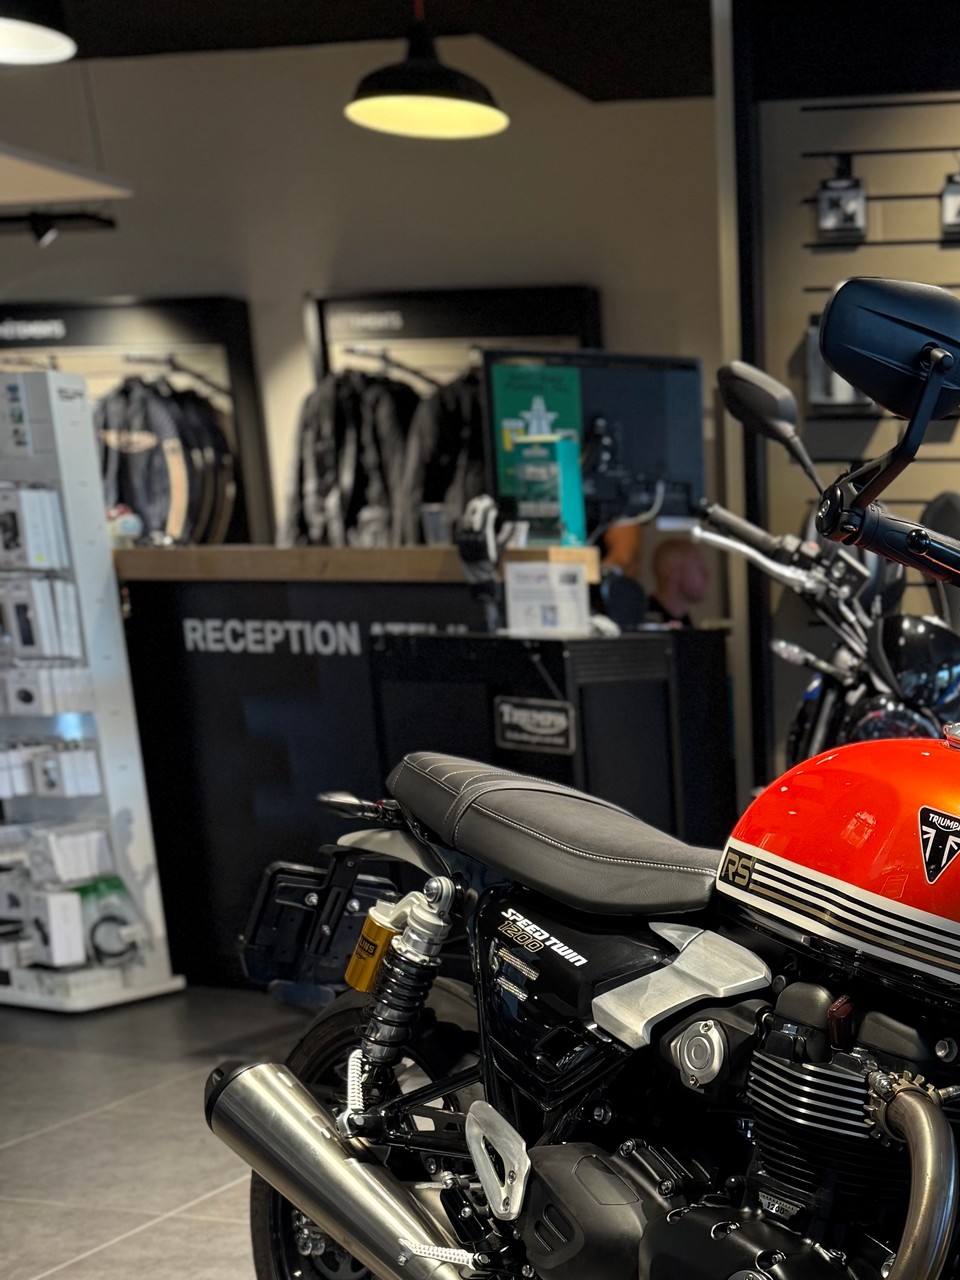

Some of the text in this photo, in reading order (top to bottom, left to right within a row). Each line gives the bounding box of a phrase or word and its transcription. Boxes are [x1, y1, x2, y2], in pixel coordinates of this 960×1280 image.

[182, 618, 362, 656] RECEPTION
[721, 851, 753, 887] RS
[498, 920, 545, 953] 1200
[501, 908, 588, 967] SPEED TWIN
[766, 1201, 785, 1215] 1200
